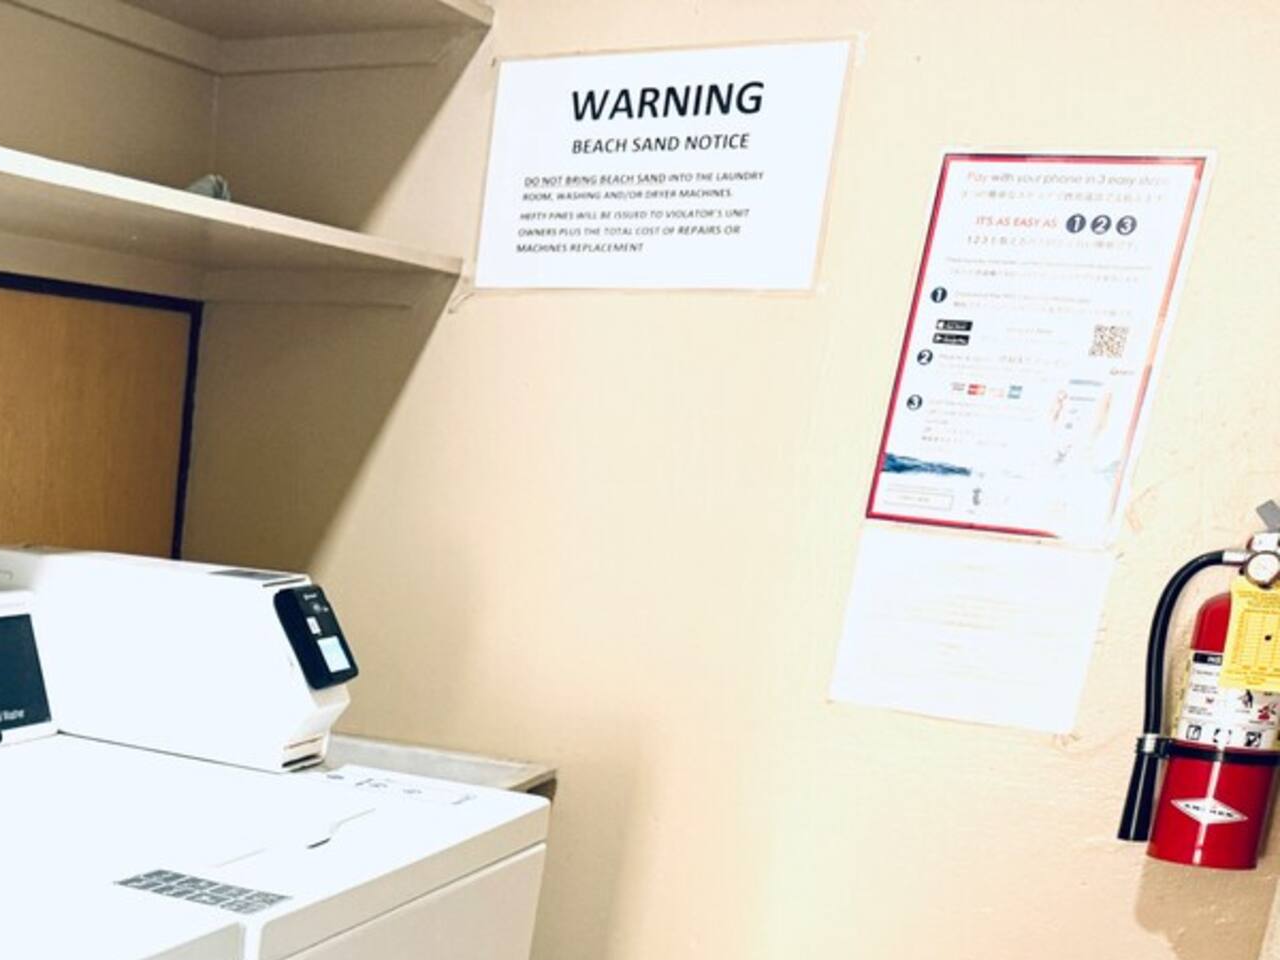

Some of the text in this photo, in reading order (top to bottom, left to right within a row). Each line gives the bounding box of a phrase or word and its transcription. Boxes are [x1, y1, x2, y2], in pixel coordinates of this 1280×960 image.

[572, 81, 765, 121] WARNING
[572, 132, 750, 154] BEACH SAND NOTICE
[524, 171, 764, 187] DO NOT BRING BEACH SAND INTO THE LAUNDRY
[967, 172, 988, 184] Pay
[991, 172, 1014, 183] with
[1017, 174, 1040, 185] your
[1042, 172, 1083, 186] phone
[1086, 173, 1096, 184] in
[1097, 173, 1106, 184] 3
[1108, 175, 1136, 187] easy
[522, 192, 554, 201] ROOM,
[556, 191, 601, 200] WASHING
[604, 190, 643, 200] AND/OR
[645, 190, 676, 199] DRYER
[520, 208, 750, 220] HEFTY FINES WILL BE ISSUED TO VIOLATOR'S UNIT
[976, 215, 994, 227] IT'S
[996, 216, 1011, 227] AS
[1013, 215, 1040, 228] EASY
[1042, 217, 1059, 228] AS
[518, 225, 741, 237] OWNERS PLUS THE TOTAL COST OF REPAIRS OR
[516, 242, 644, 253] MACHINES REPLACEMENT
